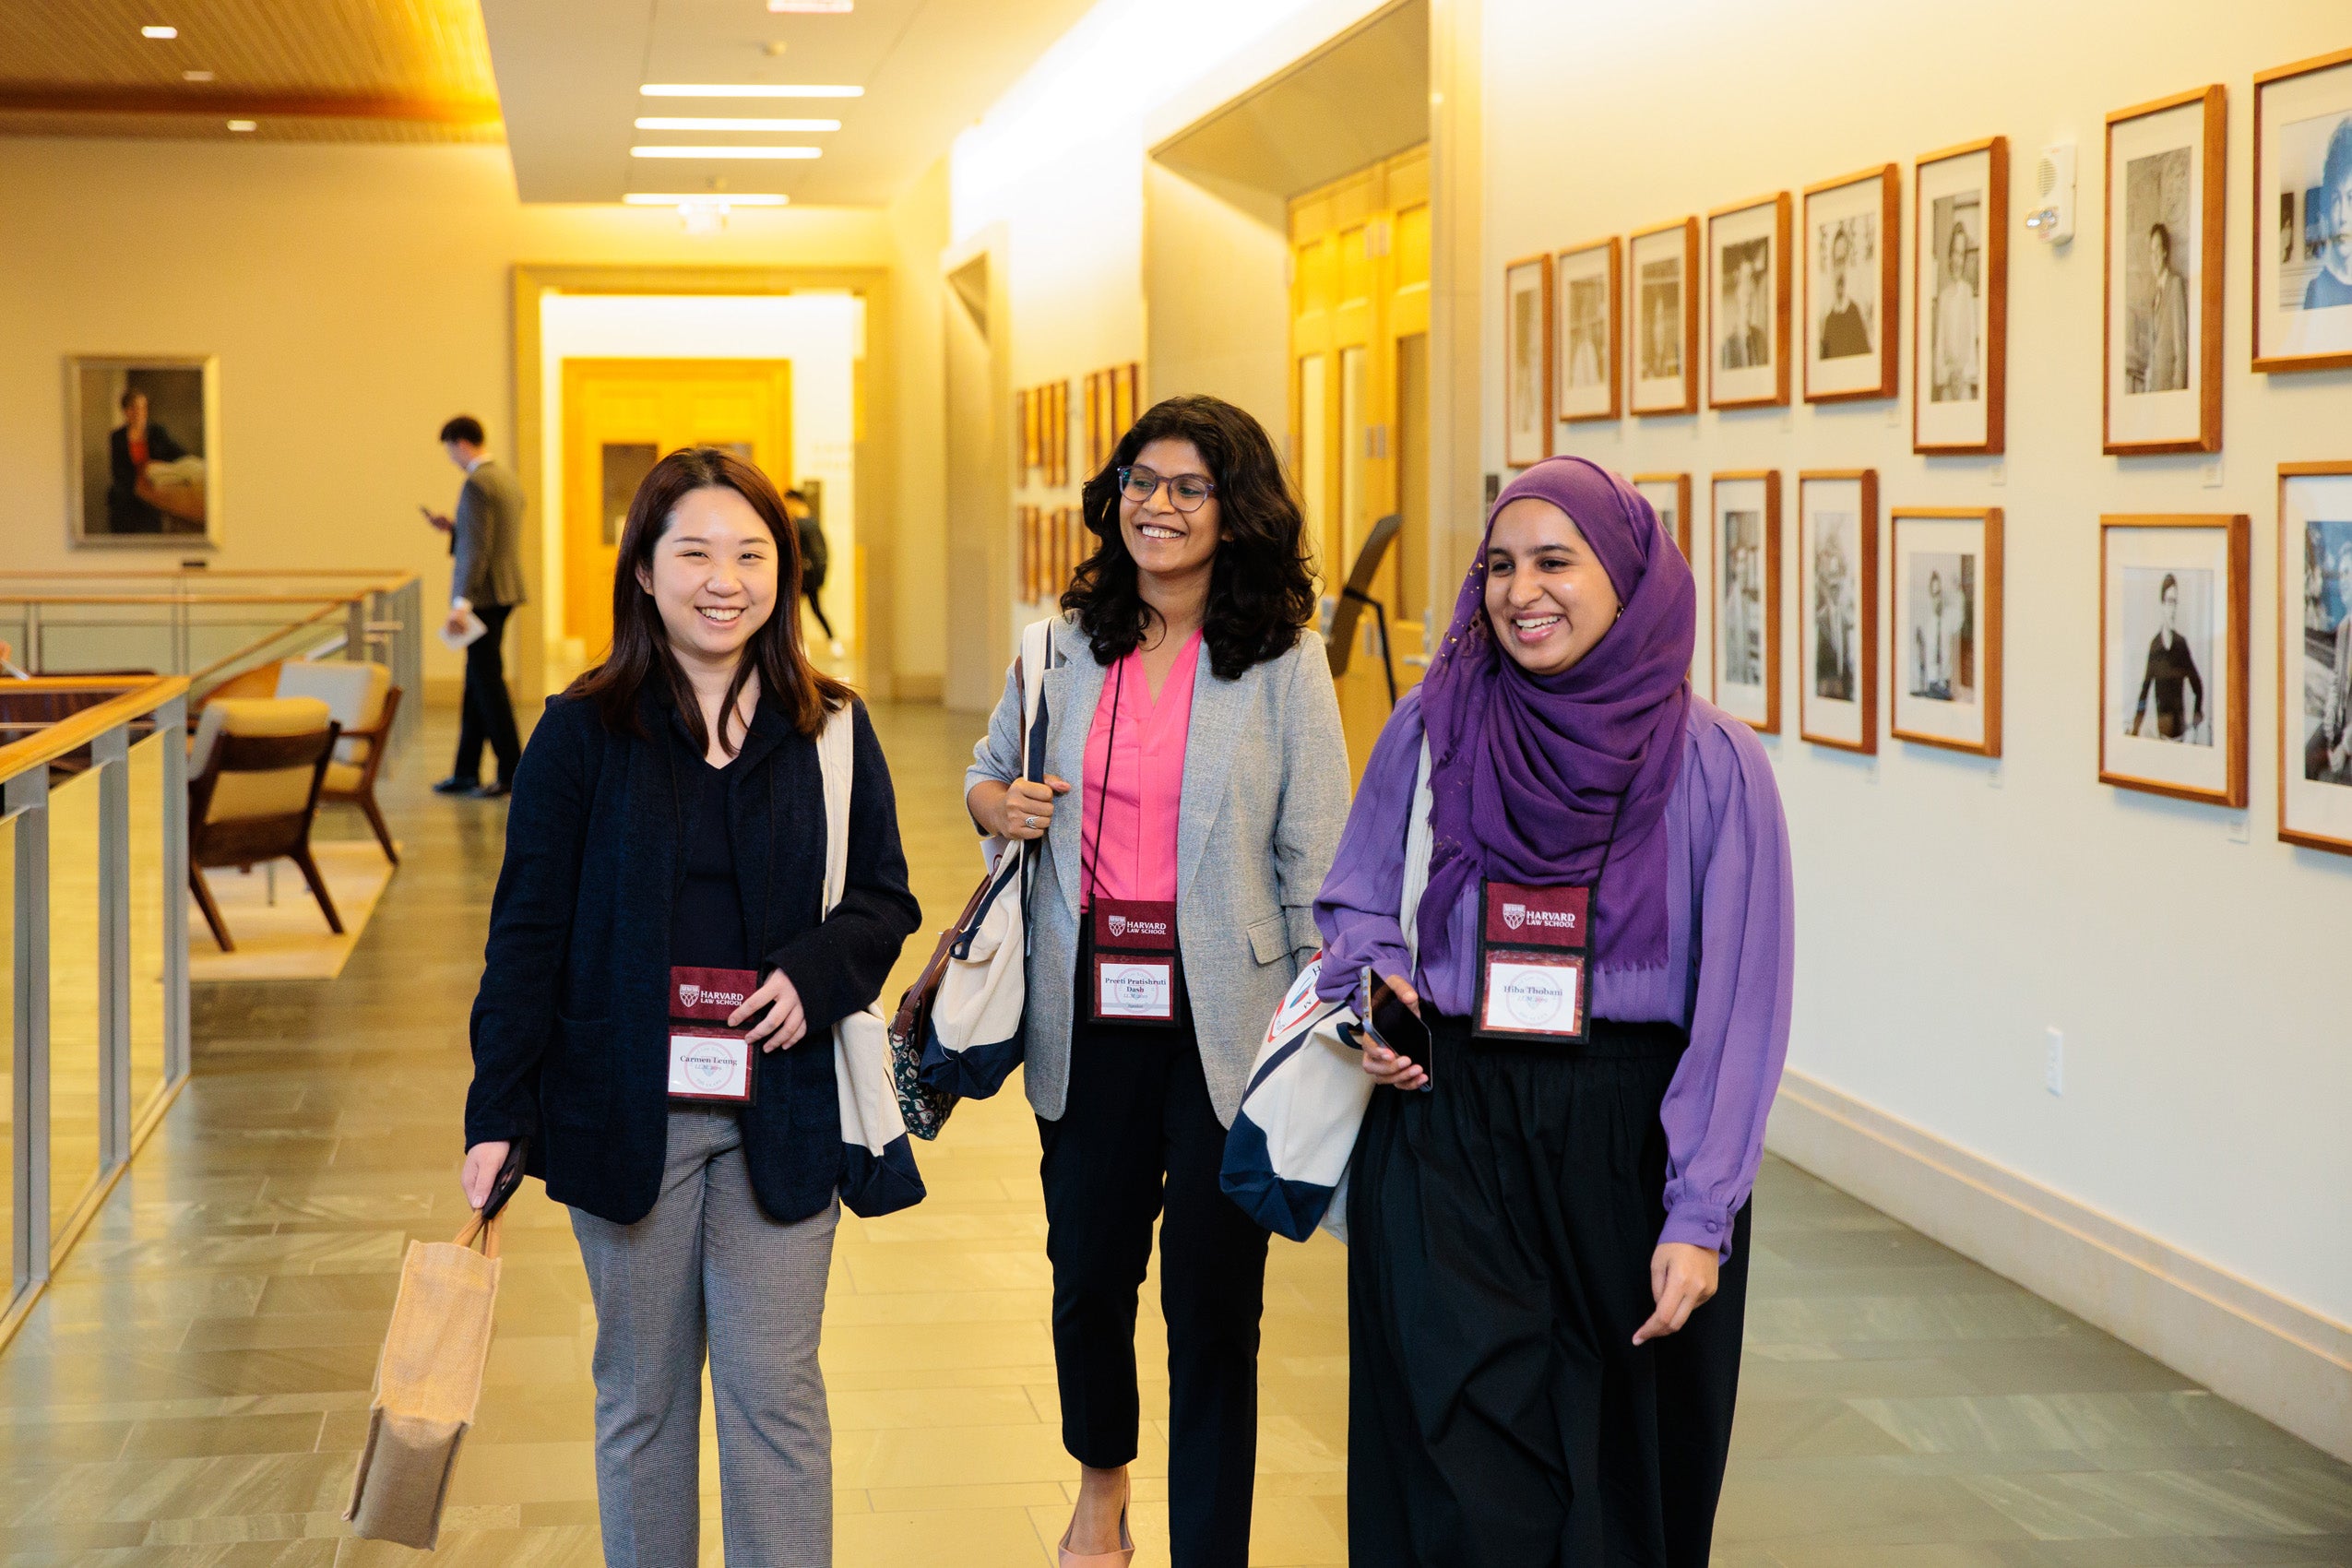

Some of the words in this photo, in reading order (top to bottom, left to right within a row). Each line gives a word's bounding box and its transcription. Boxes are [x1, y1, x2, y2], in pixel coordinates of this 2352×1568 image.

[1526, 911, 1575, 922] HARVARD
[1126, 921, 1167, 930] HARVARD
[1503, 985, 1525, 993] Hiba
[1526, 987, 1563, 996] Thobani
[701, 991, 743, 1001] HARVARD
[680, 1055, 711, 1063] Carmen
[713, 1057, 738, 1065] Leung
